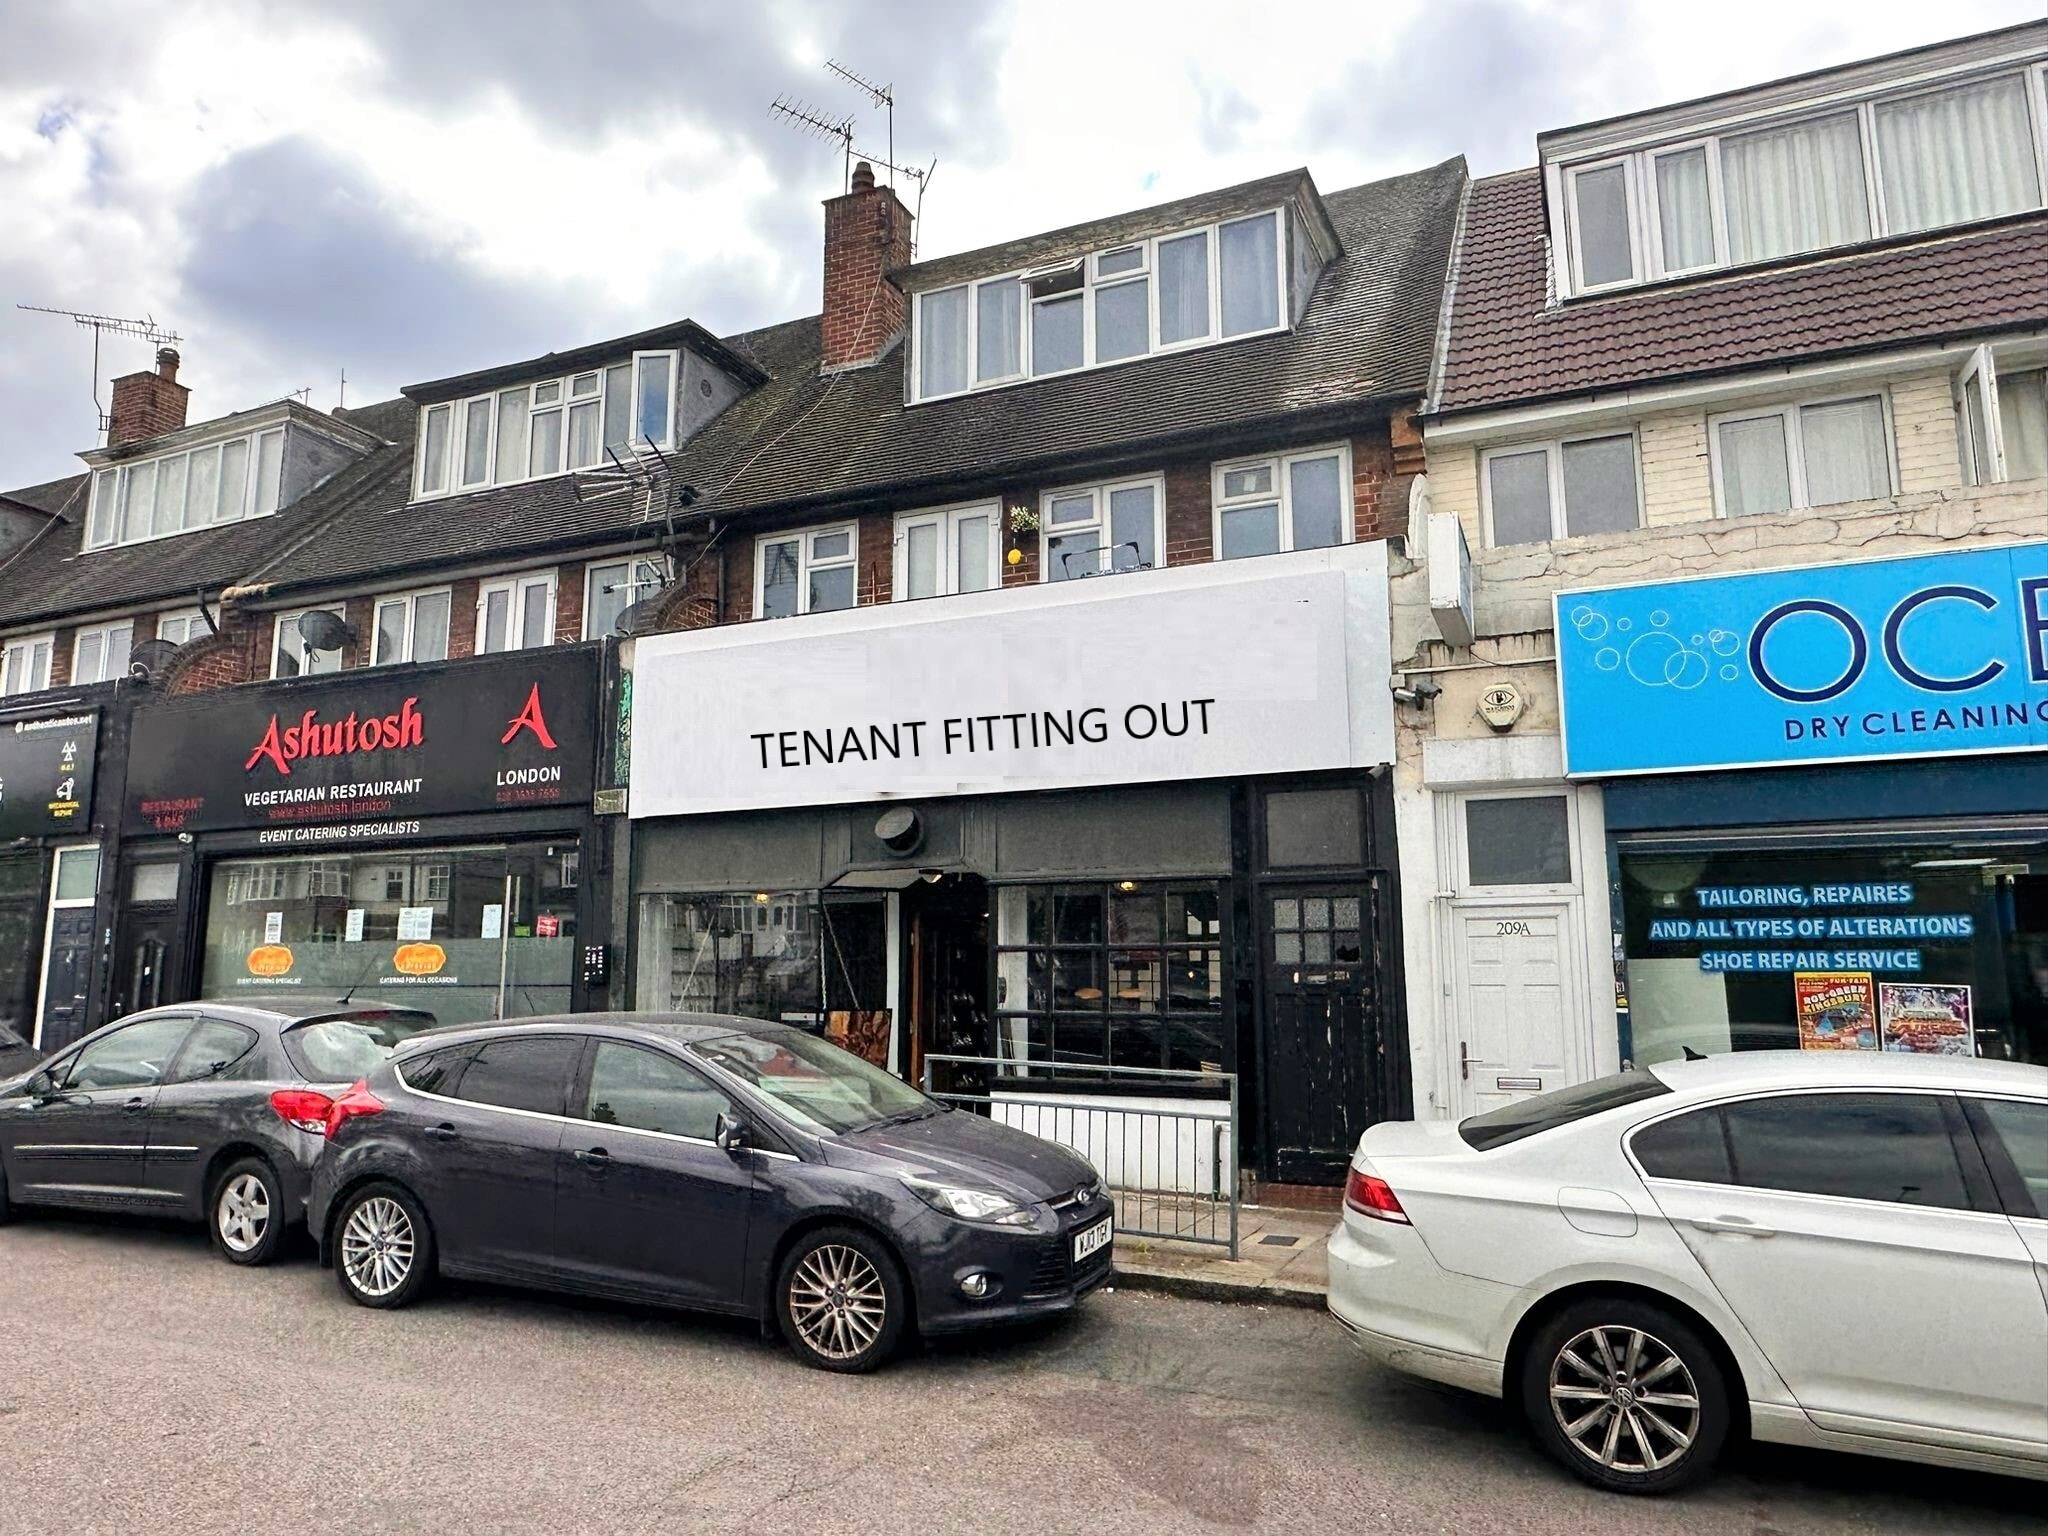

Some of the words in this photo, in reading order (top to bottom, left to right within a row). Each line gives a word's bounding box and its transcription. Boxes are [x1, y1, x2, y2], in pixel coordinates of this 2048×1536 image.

[245, 697, 424, 775] Ashutosh
[750, 721, 927, 769] TENANT
[943, 707, 1108, 755] FITTING
[1124, 698, 1215, 740] OUT
[1785, 715, 1849, 741] DRY
[496, 765, 561, 786] LONDON
[244, 787, 326, 807] VEGETARIAN
[330, 778, 423, 800] RESTAURANT
[260, 829, 294, 843] EVENT
[295, 825, 347, 840] CATERING
[349, 820, 420, 837] SPECIALISTS
[1697, 886, 1808, 908] TAILORING,
[1813, 884, 1911, 905] REPAIRES
[1496, 921, 1531, 938] 209A
[1651, 920, 1691, 939] AND
[1696, 920, 1731, 938] ALL
[1734, 919, 1794, 938] TYPES
[1798, 919, 1824, 937] OF
[1829, 915, 1972, 937] ALTERATIONS
[1701, 952, 1754, 970] SHOE
[1758, 951, 1830, 969] REPAIR
[1834, 950, 1919, 968] SERVICE
[379, 977, 405, 985] CATERING
[406, 977, 416, 985] FOR
[417, 977, 427, 985] ALL
[1803, 993, 1868, 1013] KINGSBURY
